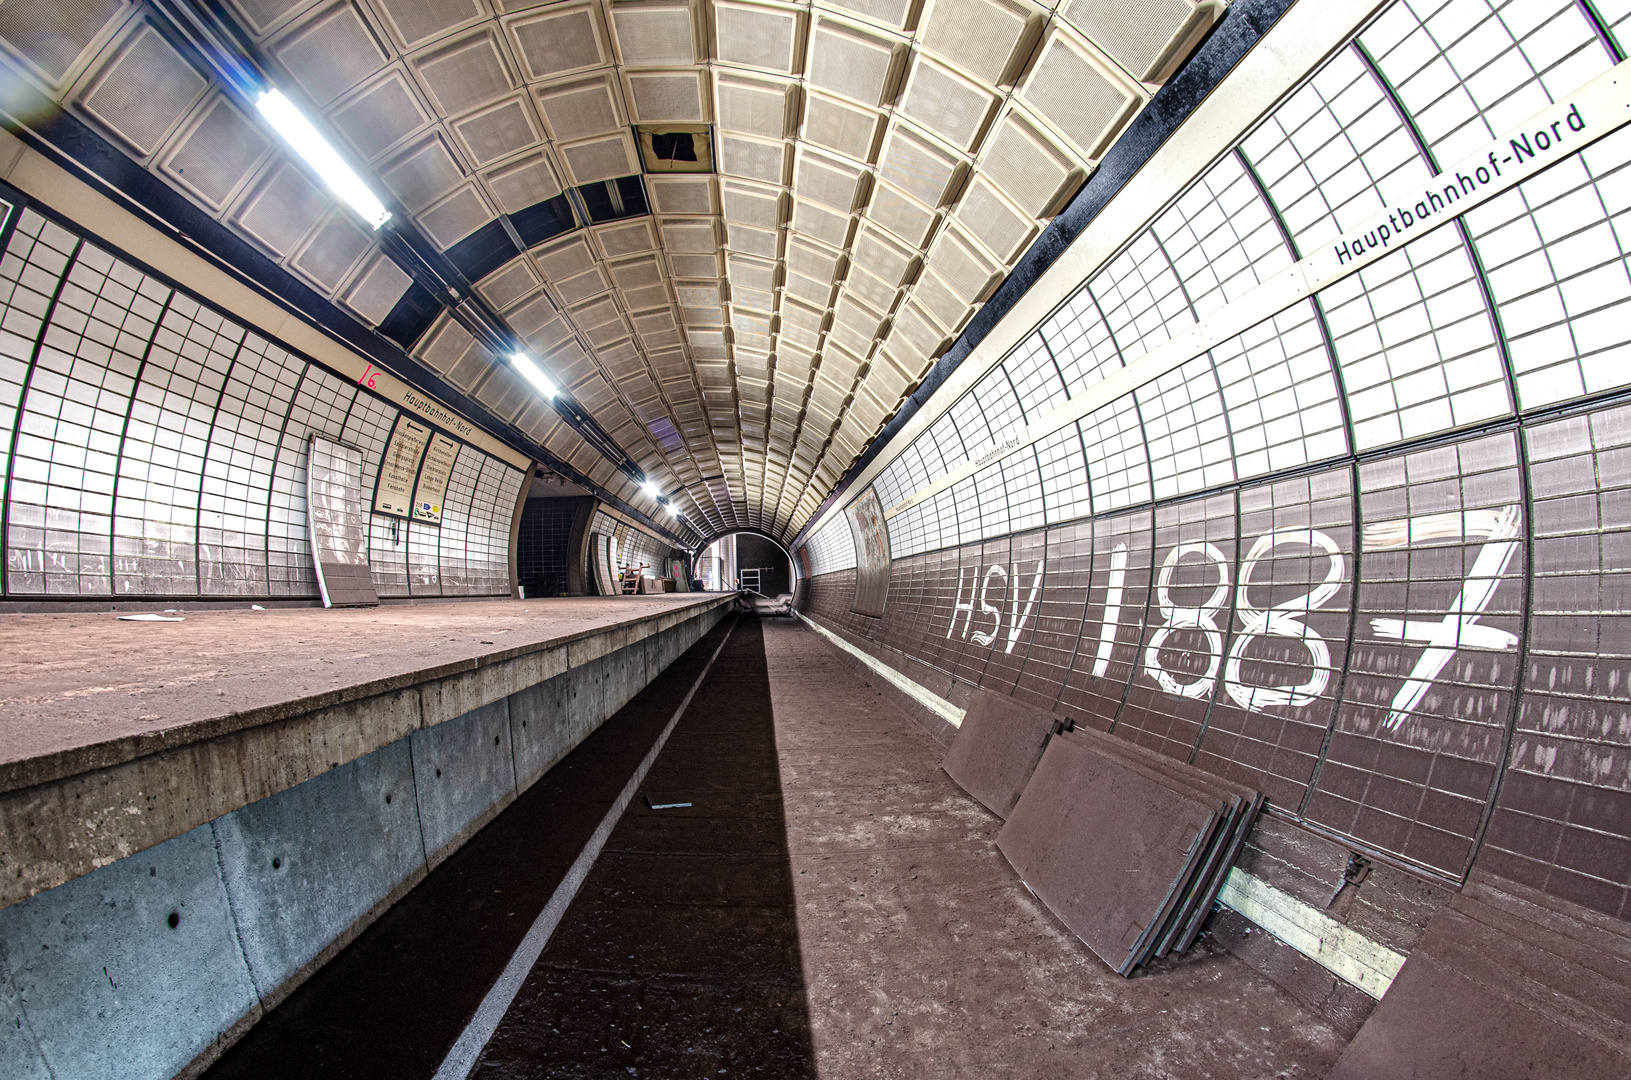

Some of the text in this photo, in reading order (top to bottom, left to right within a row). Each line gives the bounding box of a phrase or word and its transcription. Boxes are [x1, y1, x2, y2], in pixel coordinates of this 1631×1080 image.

[1333, 103, 1587, 266] Hauptbahnhof-Nord
[403, 390, 473, 436] Hauptbahnhof-Nord
[946, 503, 1522, 733] HSV 1887
